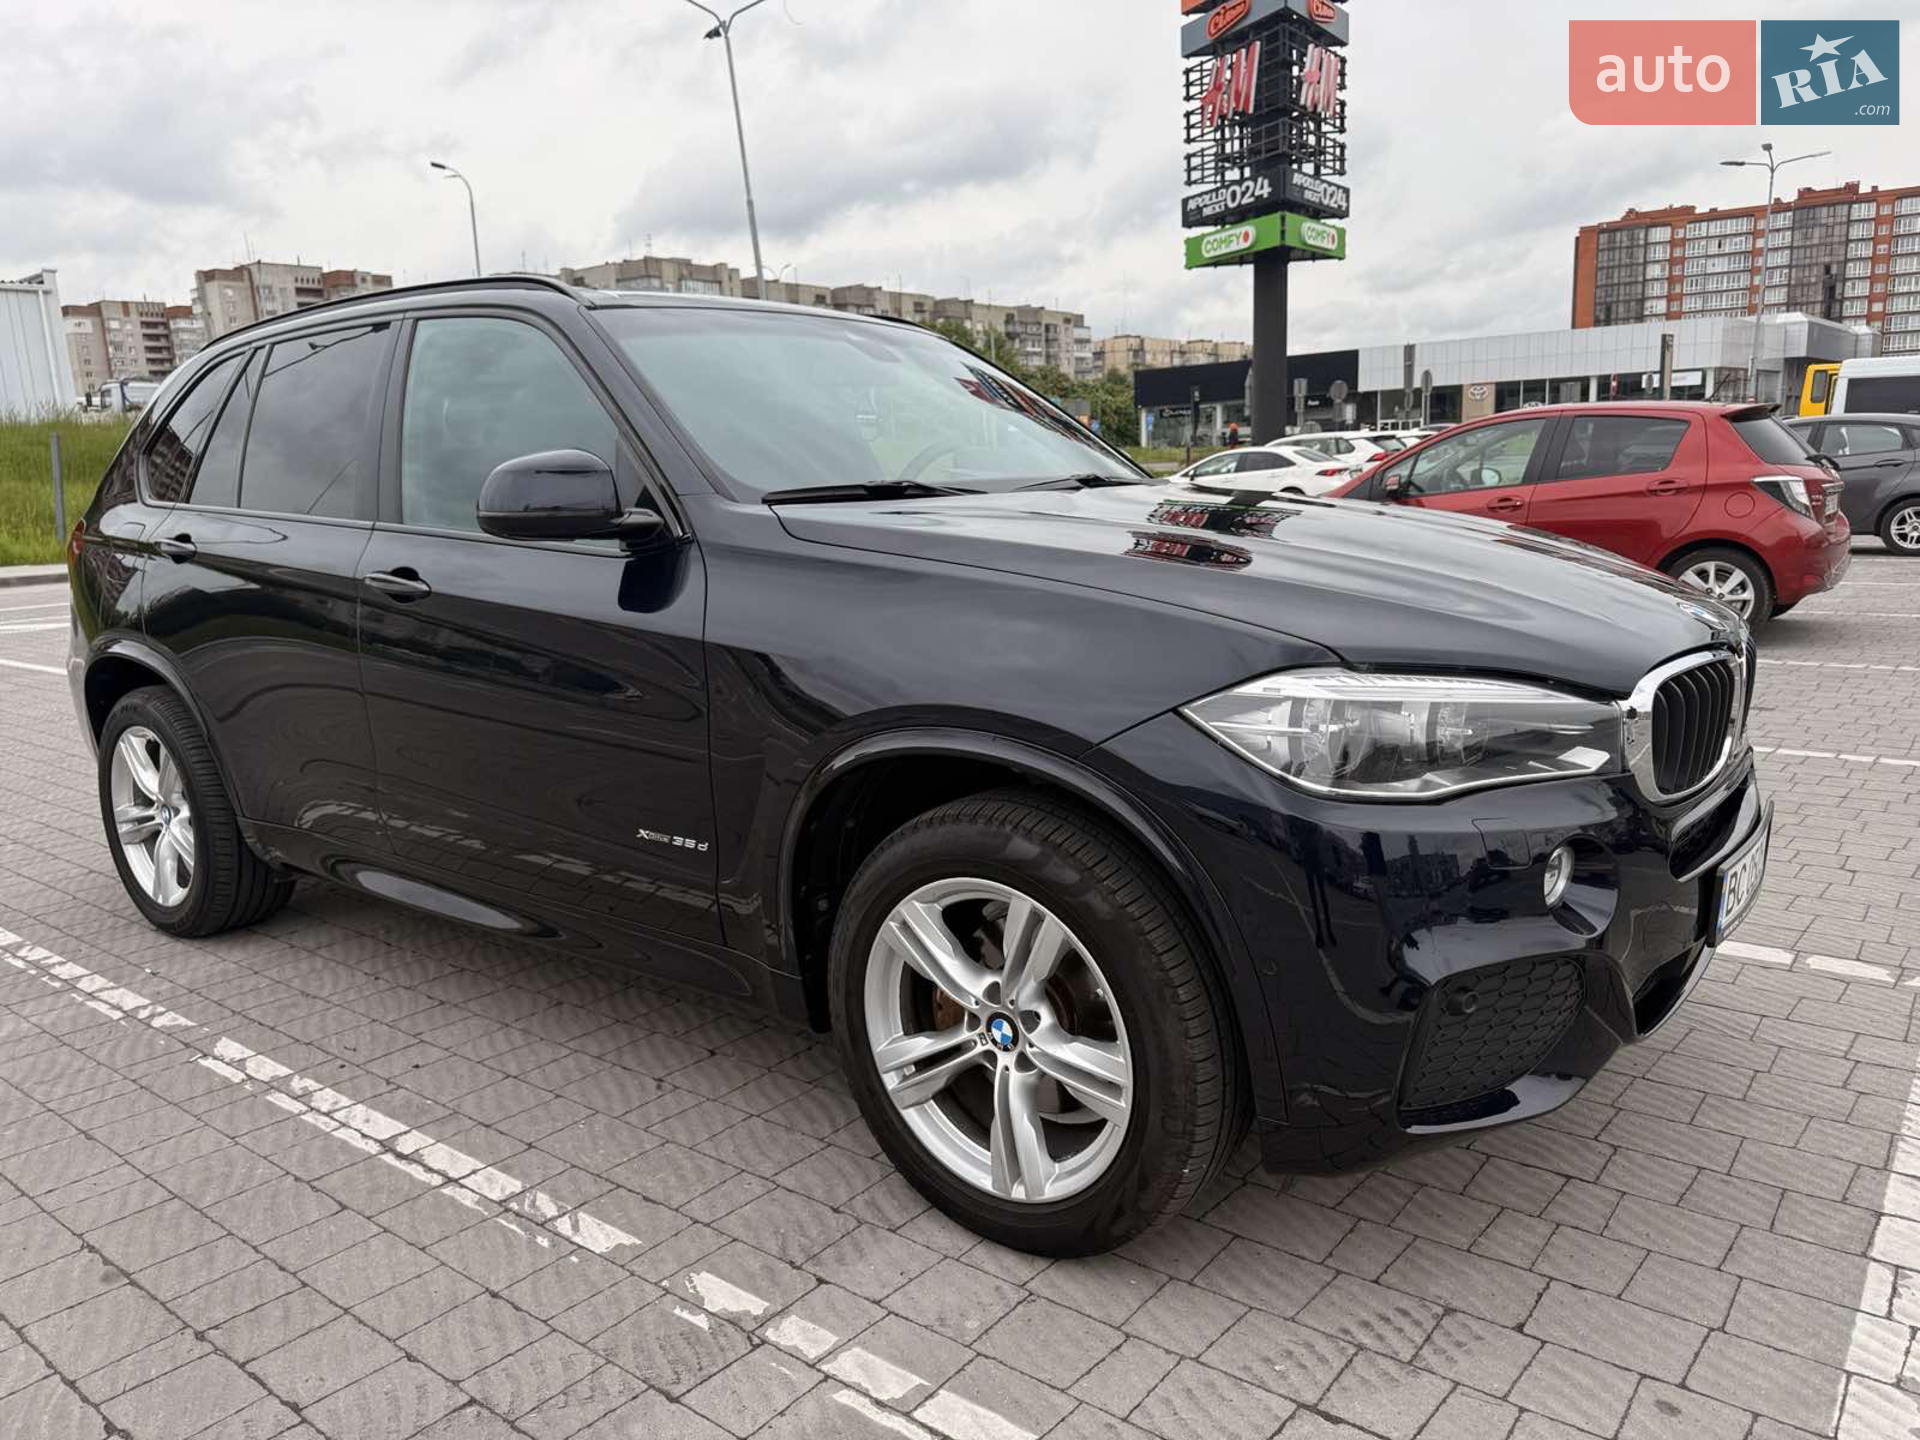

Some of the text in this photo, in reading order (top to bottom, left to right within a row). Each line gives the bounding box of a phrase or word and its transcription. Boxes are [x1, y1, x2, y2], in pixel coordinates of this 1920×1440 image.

[1187, 188, 1226, 211] APOLLO
[1226, 176, 1272, 208] 024
[1320, 182, 1348, 211] 024
[1202, 201, 1226, 217] NEXT
[1204, 230, 1242, 254] COMFY
[1726, 862, 1747, 916] BC
